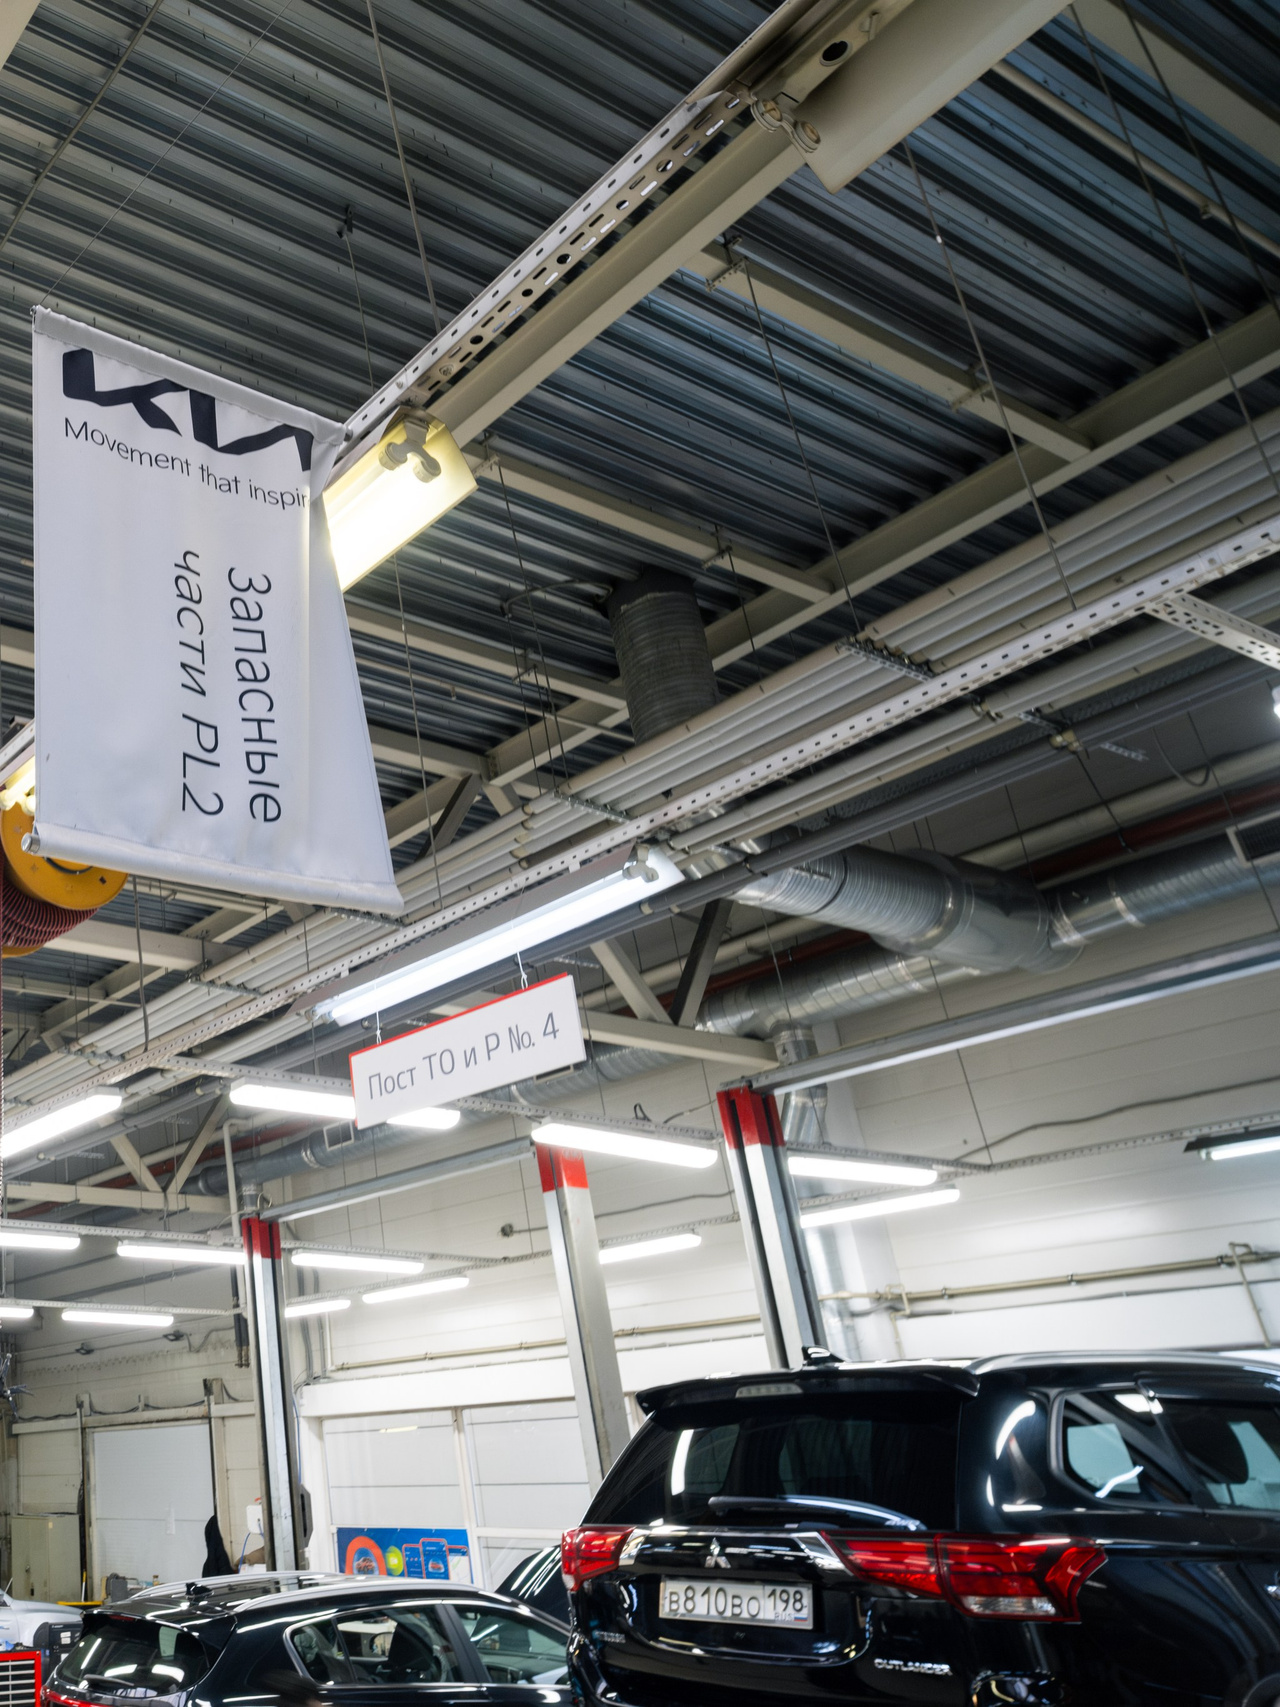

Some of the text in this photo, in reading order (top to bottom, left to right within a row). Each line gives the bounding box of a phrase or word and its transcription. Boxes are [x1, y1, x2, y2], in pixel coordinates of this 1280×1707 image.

[62, 348, 314, 472] KIA
[63, 416, 311, 511] Movement that inspir
[173, 550, 224, 818] части PL2
[227, 566, 282, 824] Запасные
[368, 1066, 417, 1099] Пост
[422, 1048, 456, 1080] ТО
[463, 1047, 477, 1068] и
[484, 1032, 500, 1061] Р
[542, 1012, 560, 1040] 4
[668, 1585, 804, 1618] В810ВО 198
[874, 1658, 954, 1676] OUTLANDER
